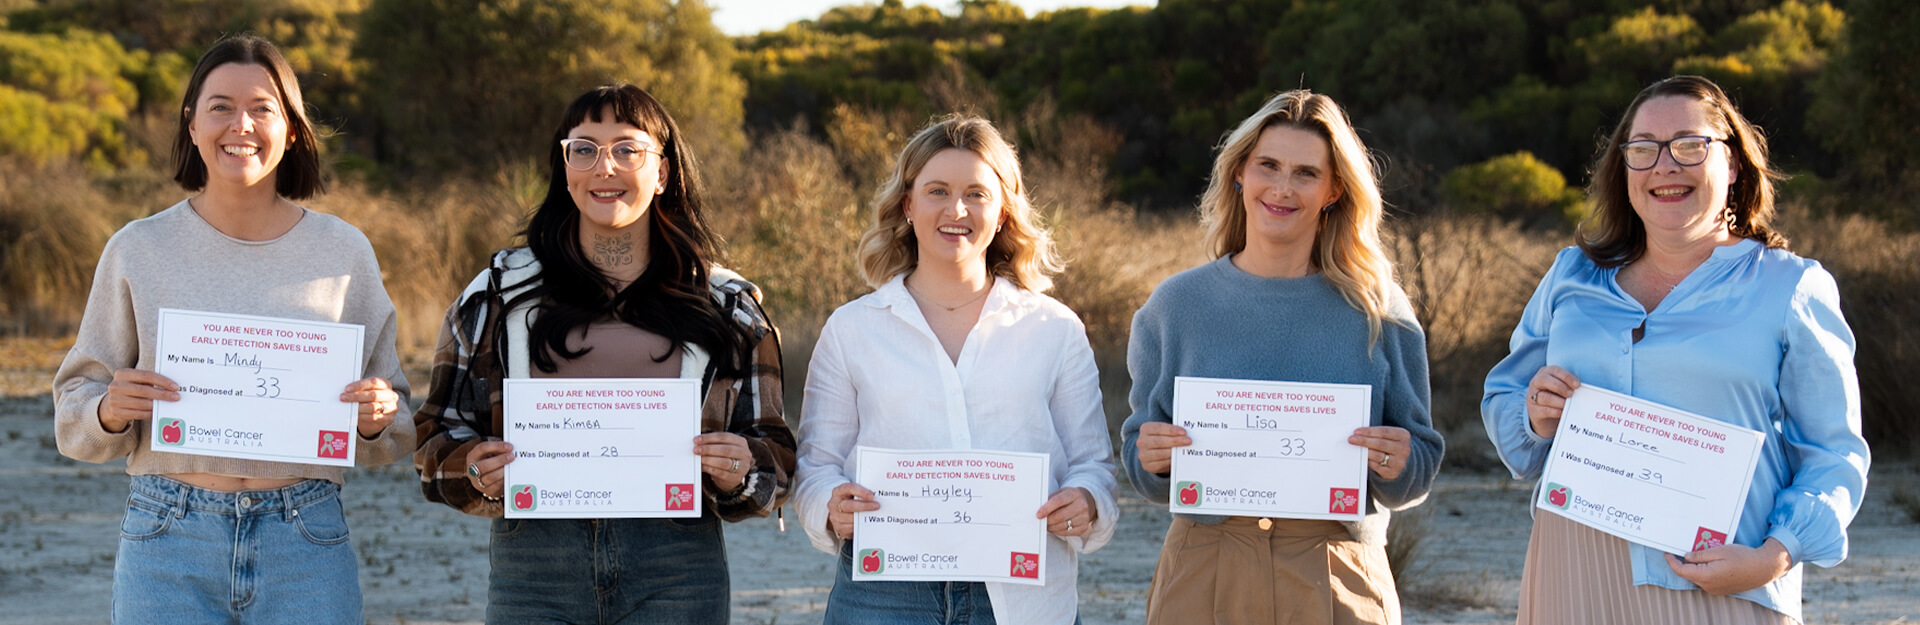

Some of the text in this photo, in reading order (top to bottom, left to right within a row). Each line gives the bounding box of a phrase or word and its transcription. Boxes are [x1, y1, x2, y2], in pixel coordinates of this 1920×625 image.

[204, 324, 327, 341] YOU ARE NEVER TOO YOUNG
[192, 336, 328, 354] EARLY DETECTION SAVES LIVES
[168, 354, 179, 363] My
[182, 355, 205, 364] Name
[225, 353, 262, 374] Mindy
[190, 386, 233, 397] Diagnosed
[256, 377, 281, 398] 33
[1234, 404, 1282, 412] DETECTION
[1184, 420, 1195, 429] My
[1246, 414, 1277, 429] Lisa
[1609, 402, 1727, 441] YOU ARE NEVER TOO YOUNG
[190, 426, 263, 440] Bowel Cancer
[1570, 424, 1581, 433] My
[1582, 428, 1604, 439] Name
[1595, 412, 1725, 454] EARLY DETECTION SAVES LIVES
[189, 436, 263, 447] AUSTRALIA
[1206, 450, 1246, 459] Diagnosed
[1280, 438, 1306, 456] 33
[538, 451, 580, 460] Diagnosed
[600, 447, 618, 457] 28
[985, 461, 1013, 469] YOUNG
[1566, 452, 1582, 462] Was
[1584, 458, 1624, 476] Diagnosed
[1639, 468, 1663, 484] 39
[541, 490, 612, 499] Bowel Cancer
[922, 484, 972, 503] Hayley
[1206, 487, 1277, 498] Bowel Cancer
[1573, 504, 1642, 531] AUSTRALIA
[1574, 495, 1644, 524] Bowel Cancer
[887, 517, 928, 525] Diagnosed
[954, 511, 972, 523] 36
[888, 553, 958, 562] Bowel Cancer
